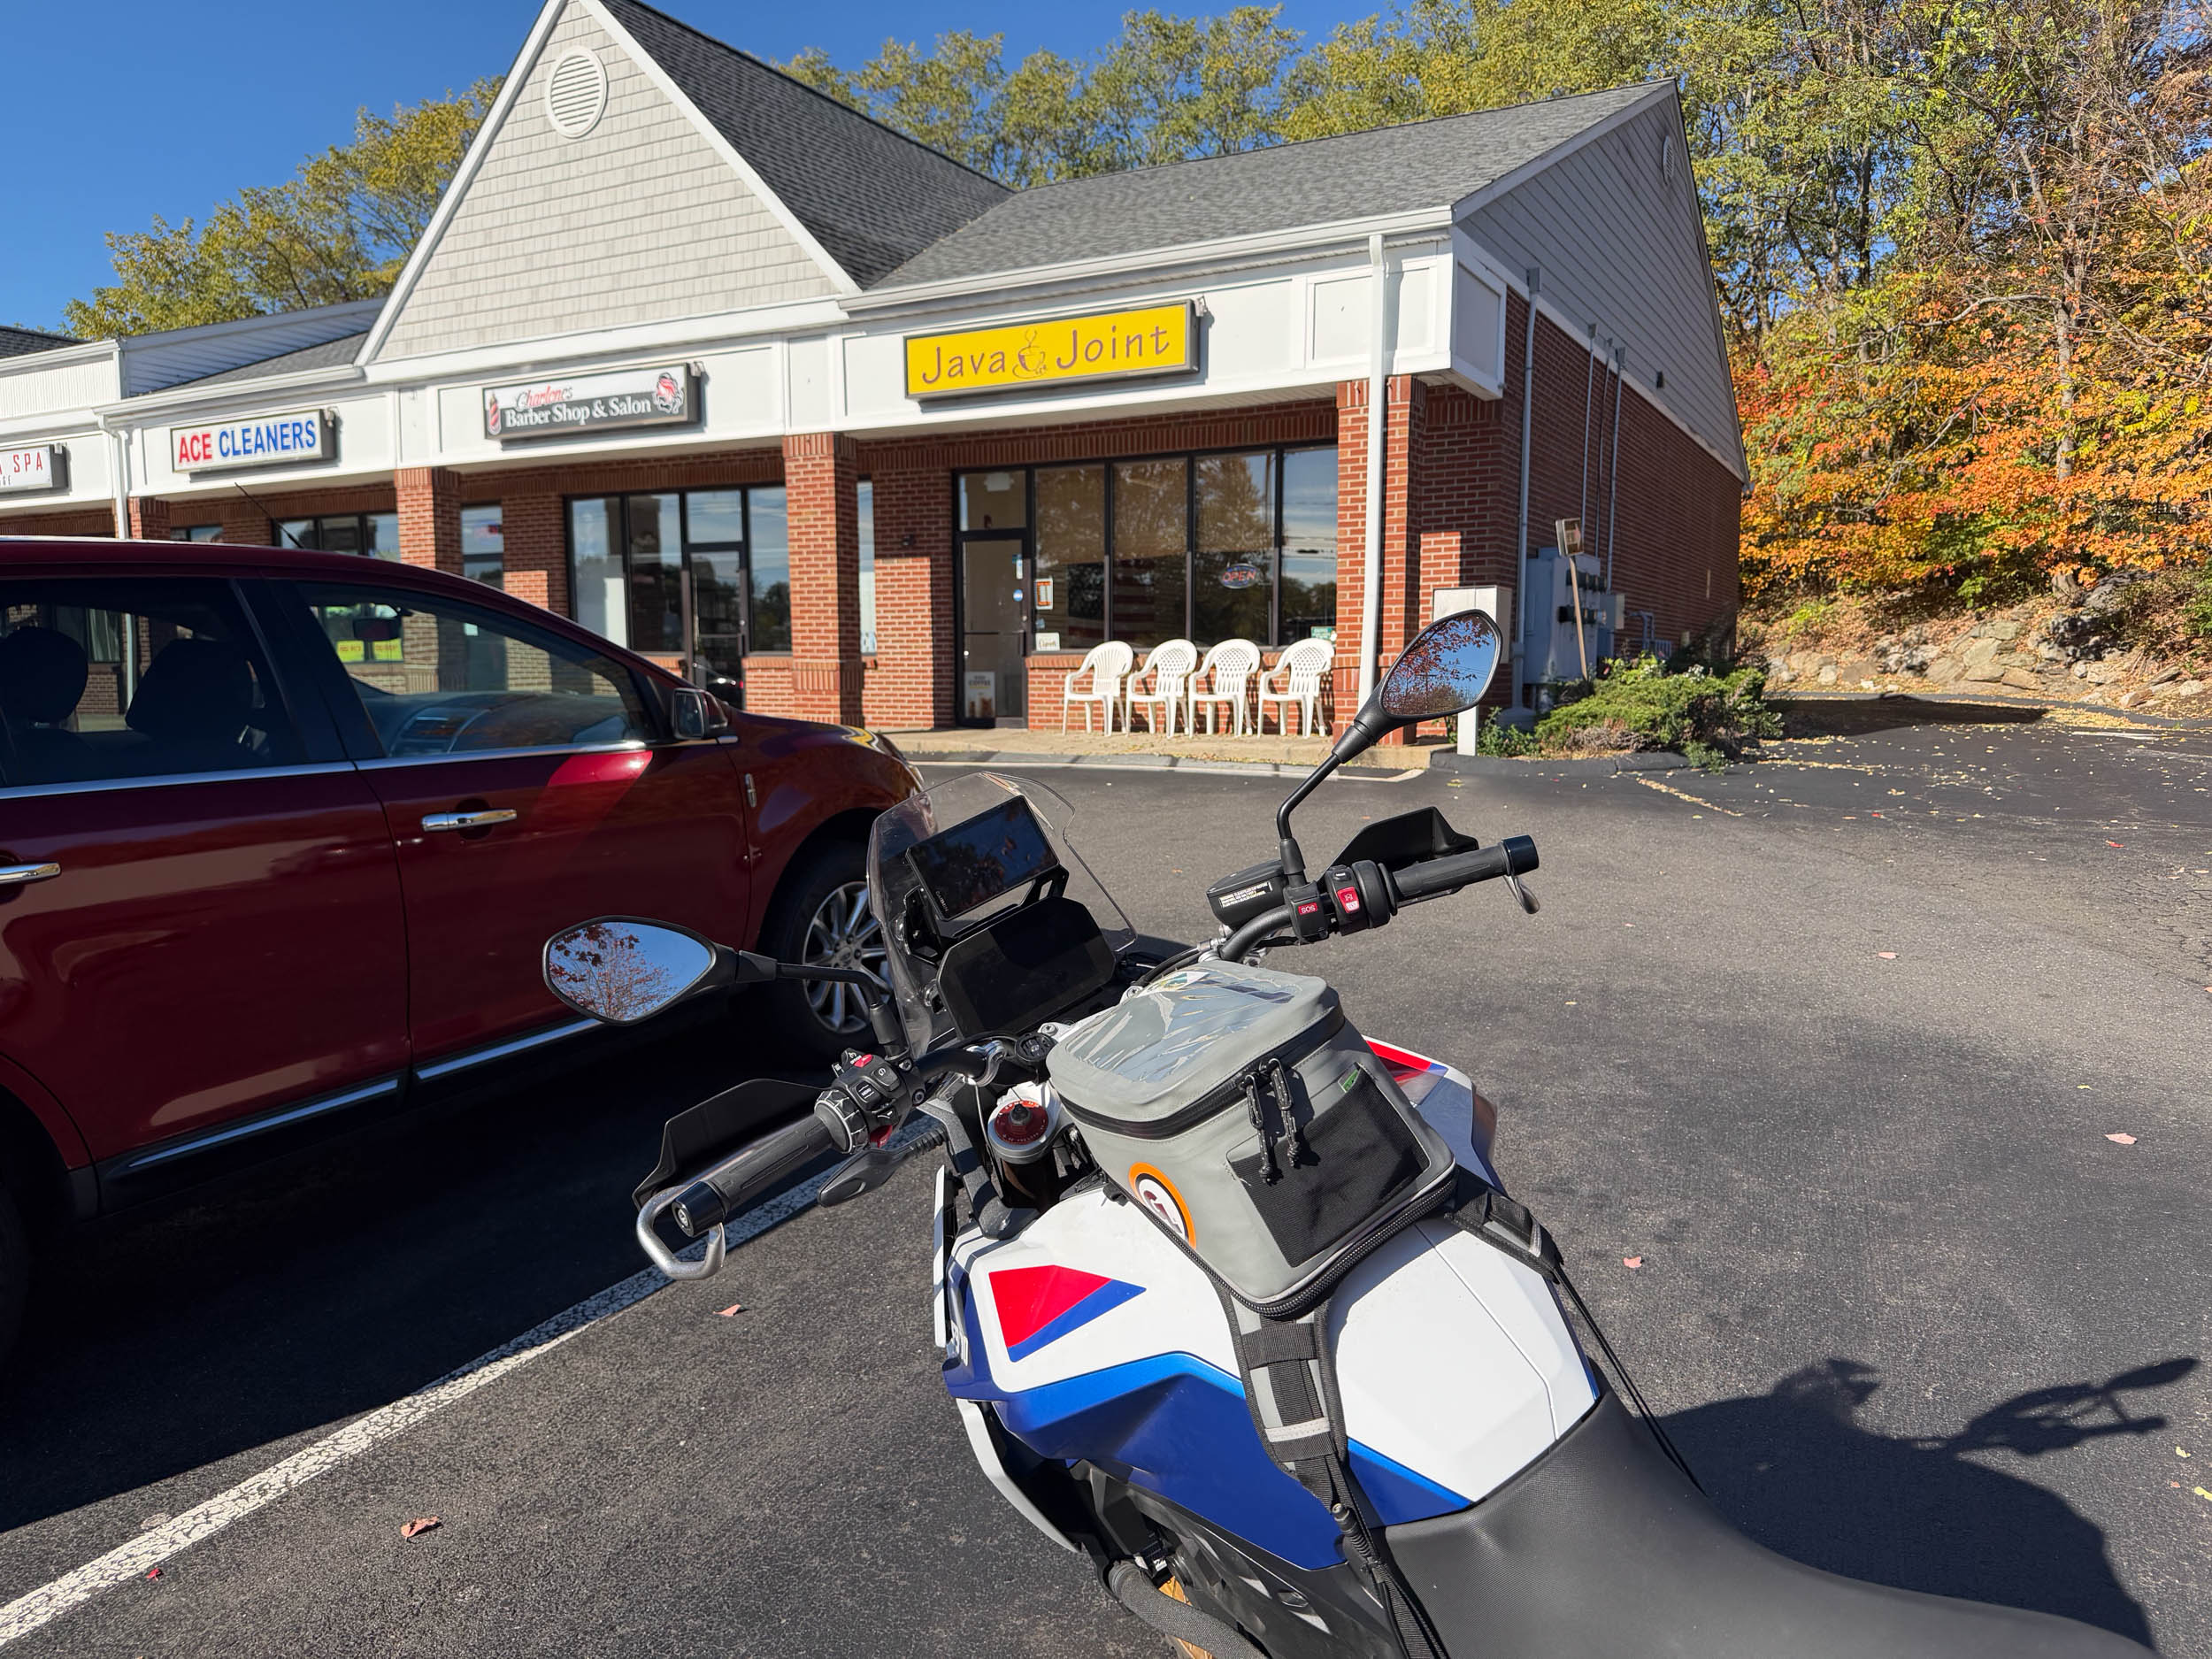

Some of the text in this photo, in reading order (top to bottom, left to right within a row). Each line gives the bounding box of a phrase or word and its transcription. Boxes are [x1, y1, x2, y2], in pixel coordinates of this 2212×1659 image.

[922, 325, 1170, 384] Java Joint
[505, 396, 652, 428] Barber Shop & Salon
[179, 419, 317, 464] ACE CLEANERS
[12, 450, 43, 473] SPA
[1223, 571, 1256, 581] OPEN
[1301, 904, 1317, 914] SOS
